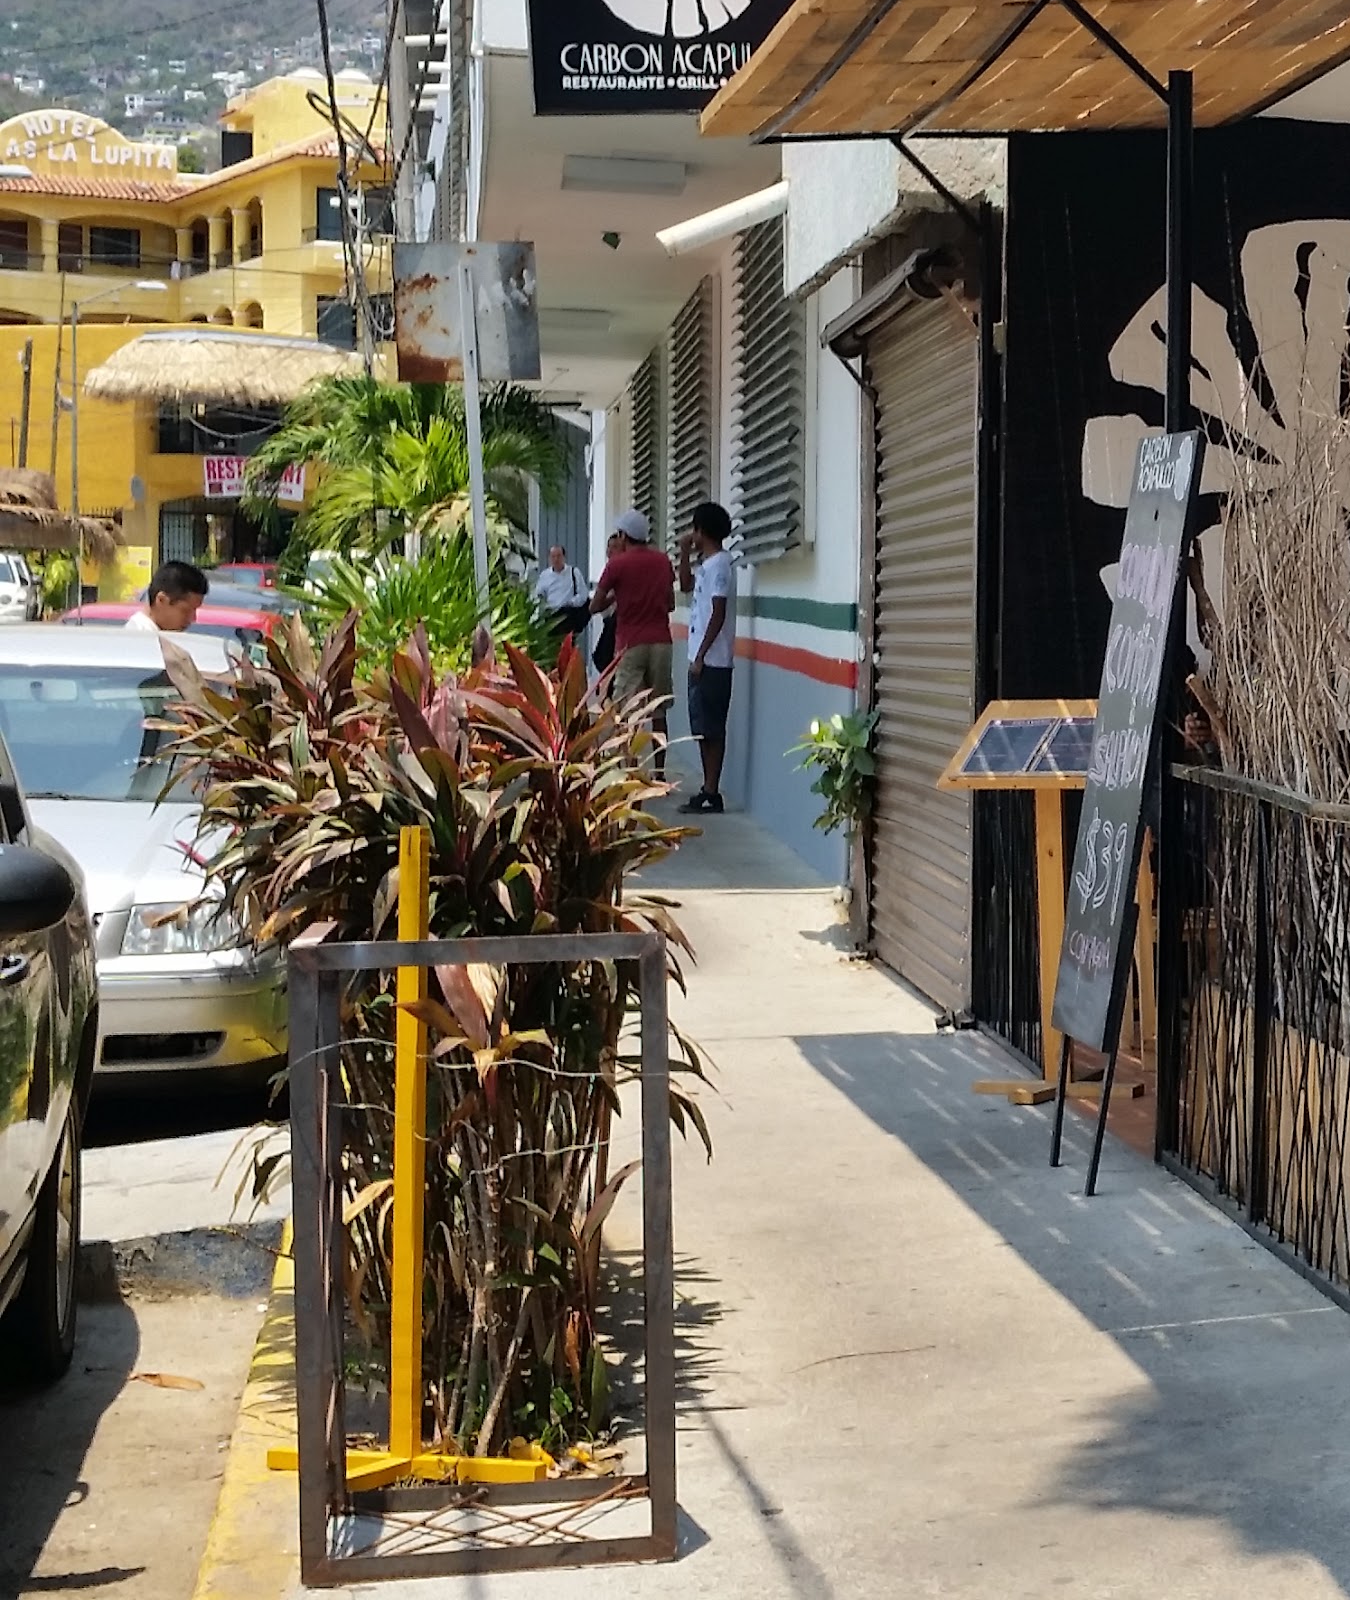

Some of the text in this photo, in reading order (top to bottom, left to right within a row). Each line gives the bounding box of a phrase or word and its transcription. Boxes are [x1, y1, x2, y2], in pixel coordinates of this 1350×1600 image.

[560, 43, 663, 75] CARBON
[562, 75, 719, 90] RESTAURANTE GRILL
[21, 113, 97, 144] HOTEL
[47, 140, 78, 163] LA
[90, 143, 172, 170] LUPITA
[1140, 434, 1173, 467] CARBON
[1076, 807, 1128, 926] $39
